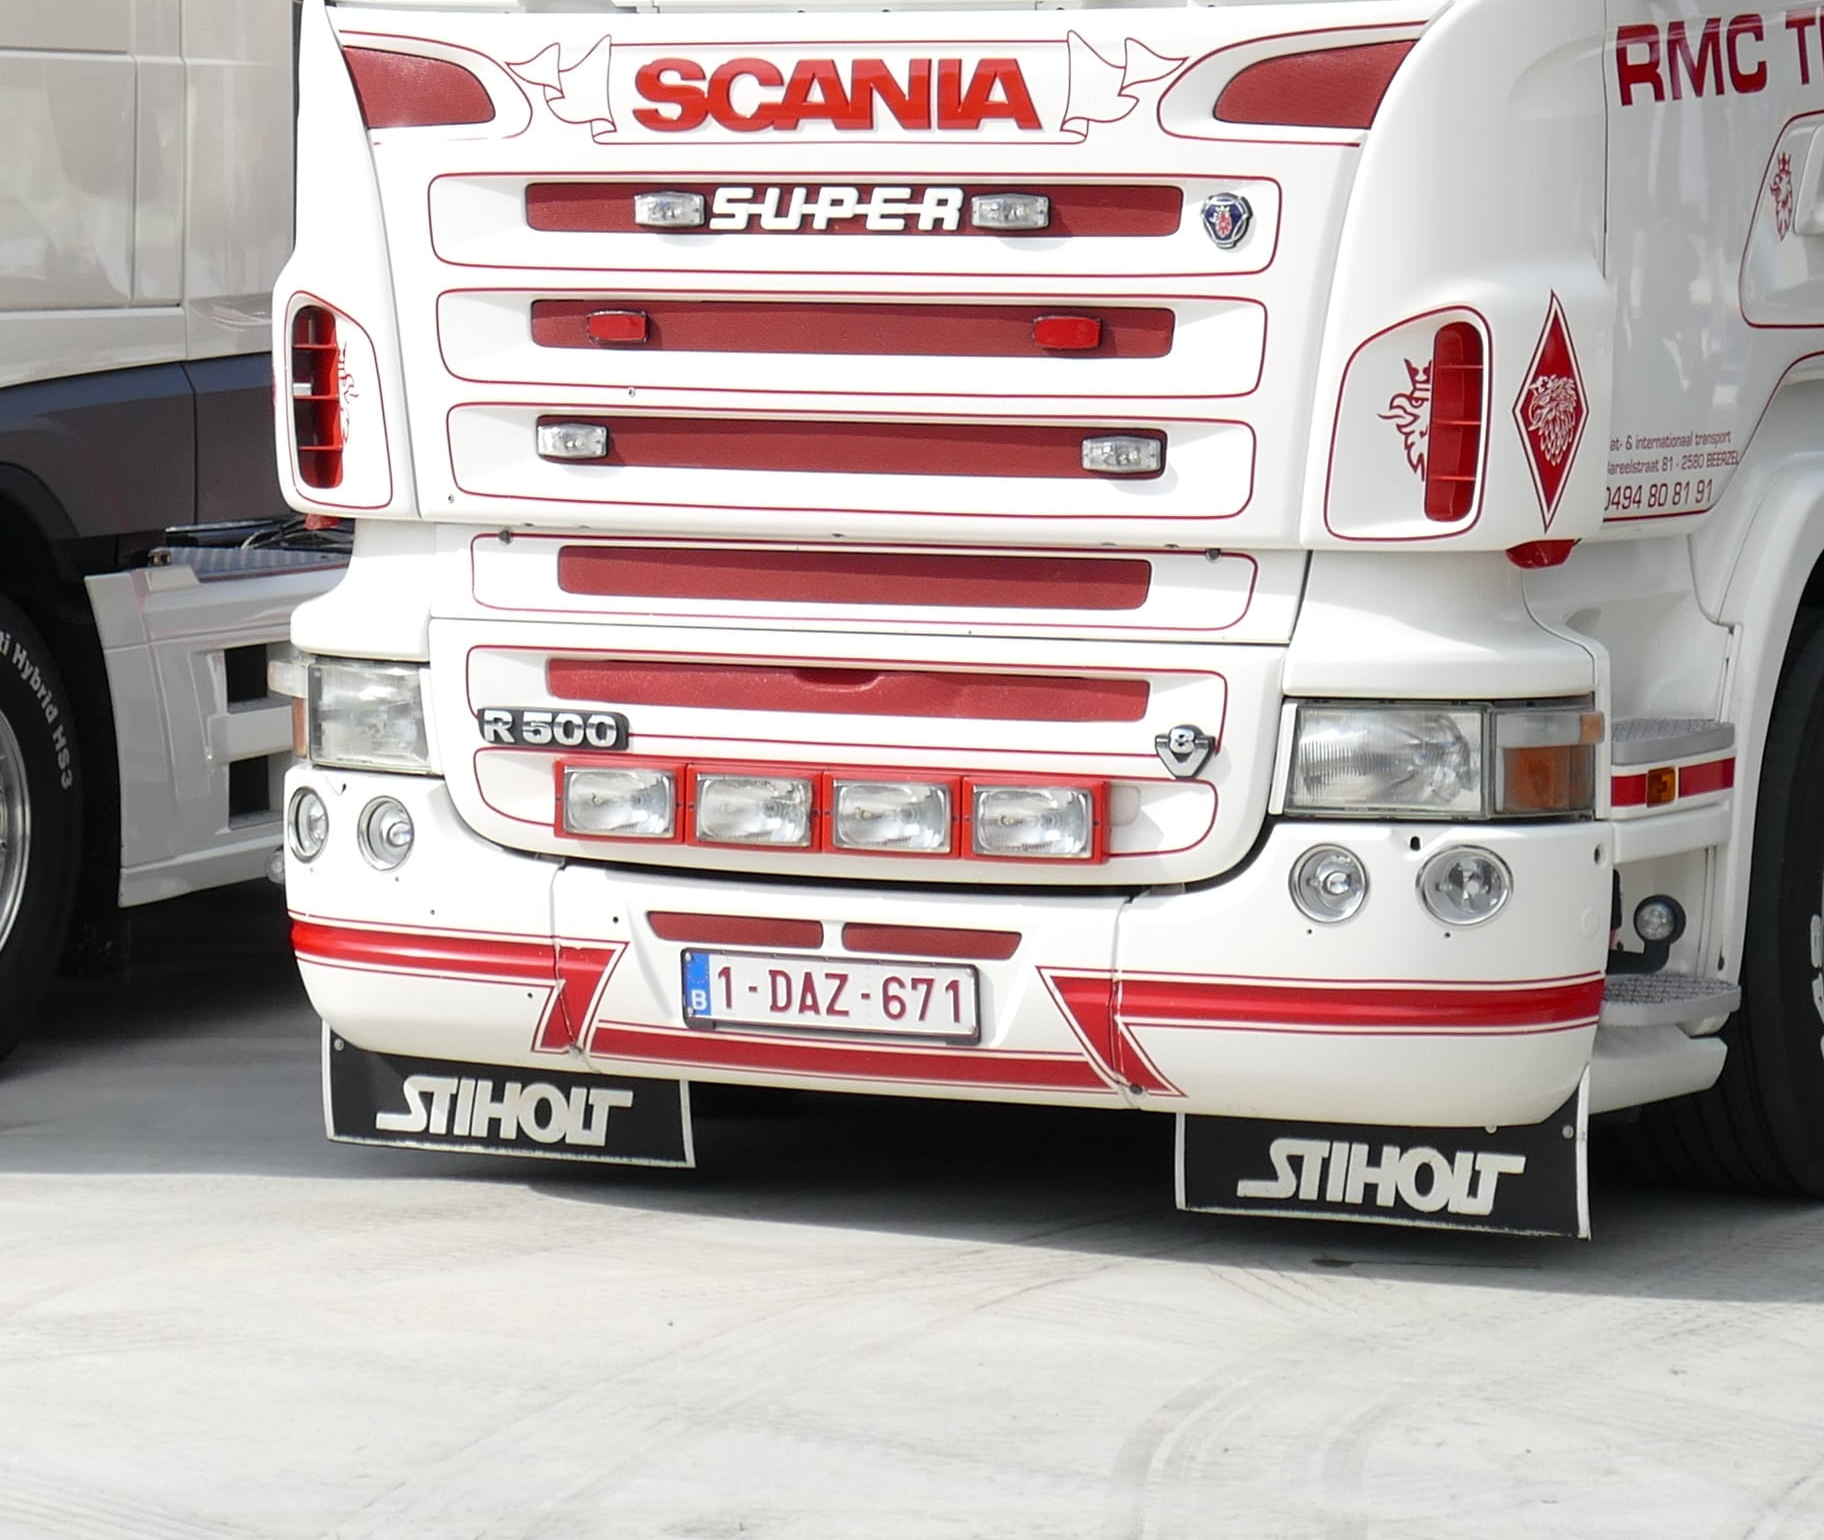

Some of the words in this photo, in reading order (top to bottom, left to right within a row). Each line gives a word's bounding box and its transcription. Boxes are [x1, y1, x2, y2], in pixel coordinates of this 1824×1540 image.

[1615, 13, 1768, 107] RMC
[633, 55, 1041, 133] SCANIA
[709, 186, 965, 234] SUPER
[1609, 436, 1623, 451] at-
[1695, 431, 1731, 448] transport
[1681, 453, 1704, 470] 2580
[1706, 450, 1740, 468] BEERZEL
[1648, 483, 1668, 507] 80
[1672, 481, 1690, 505] 81
[1695, 479, 1713, 503] 91
[12, 643, 59, 724] Hybrid
[52, 723, 73, 790] HS3
[484, 709, 515, 743] R
[522, 711, 617, 748] 500
[691, 990, 707, 1010] B
[376, 1073, 634, 1148] STIHOLT
[1236, 1137, 1525, 1216] STIHOLT
